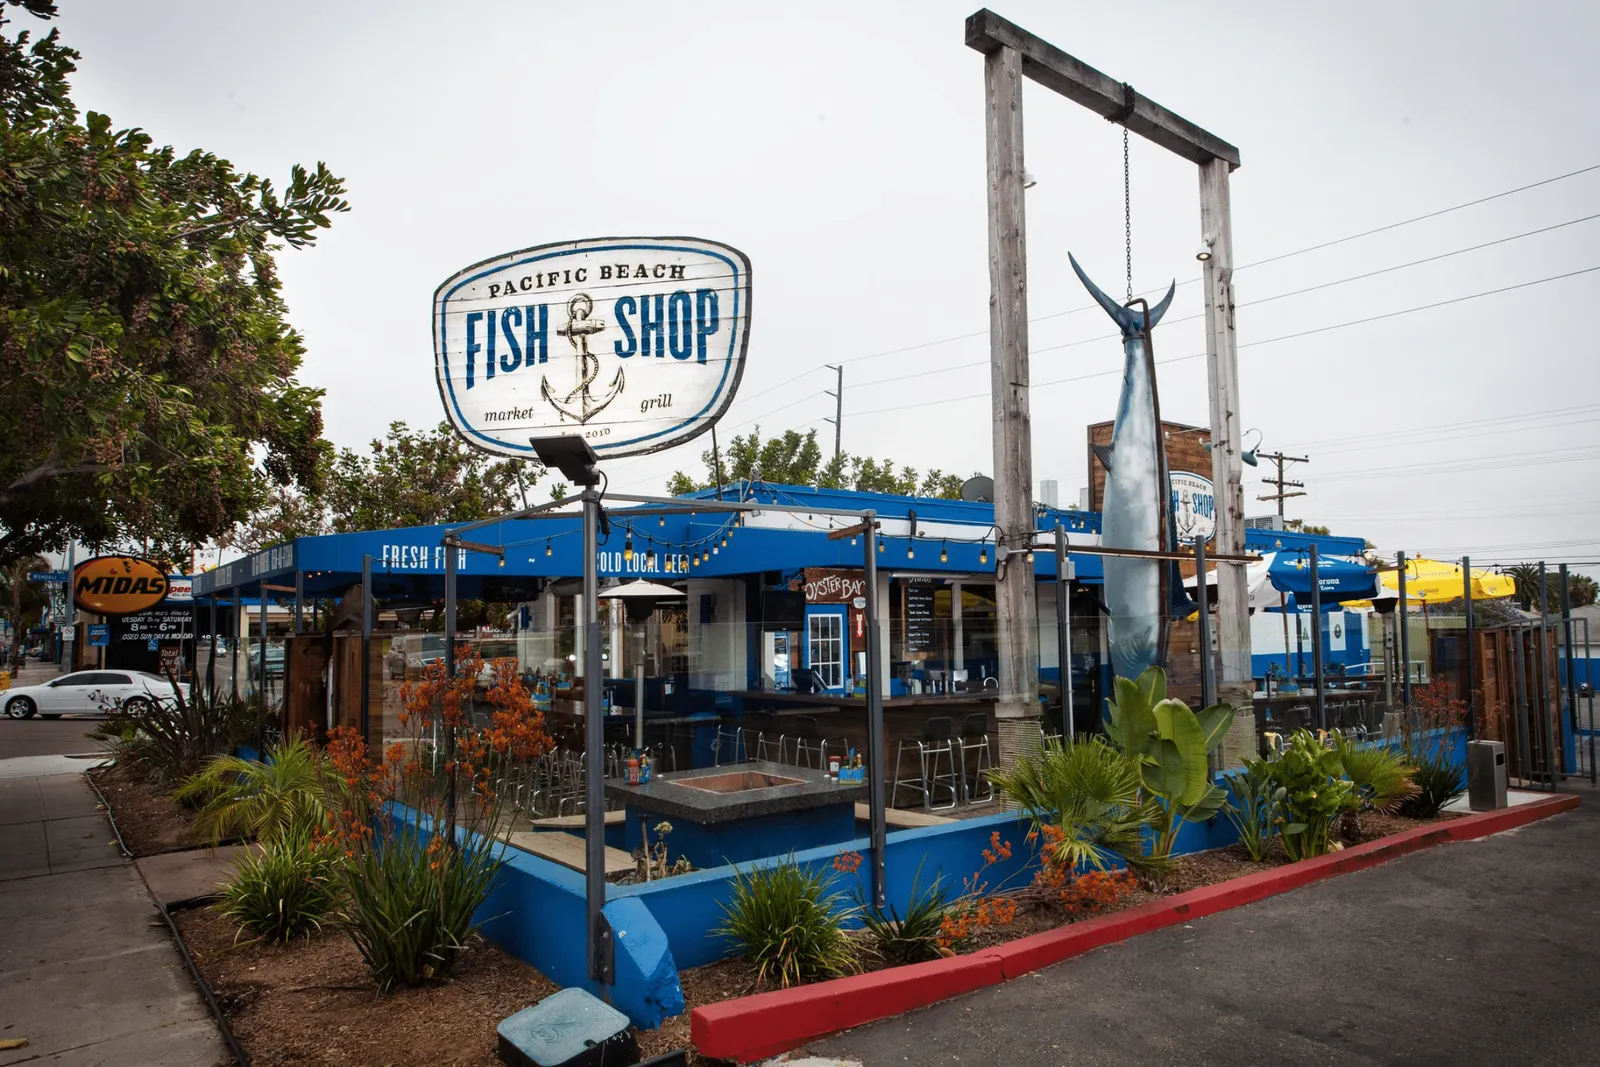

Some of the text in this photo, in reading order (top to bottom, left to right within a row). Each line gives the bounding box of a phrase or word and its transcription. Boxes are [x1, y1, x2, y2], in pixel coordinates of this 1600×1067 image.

[488, 263, 687, 299] PACIFIC BEACH
[465, 288, 719, 390] FISH SHOP
[484, 393, 673, 423] market grill
[585, 428, 611, 439] 2010
[1192, 492, 1214, 520] SHOP
[382, 544, 466, 570] FRESH FIH
[77, 576, 165, 595] MIDAS
[168, 586, 192, 594] pee
[804, 574, 866, 600] OYSTER BAY
[170, 632, 194, 640] MODAY
[160, 649, 179, 657] Total
[160, 666, 178, 674] Cre
